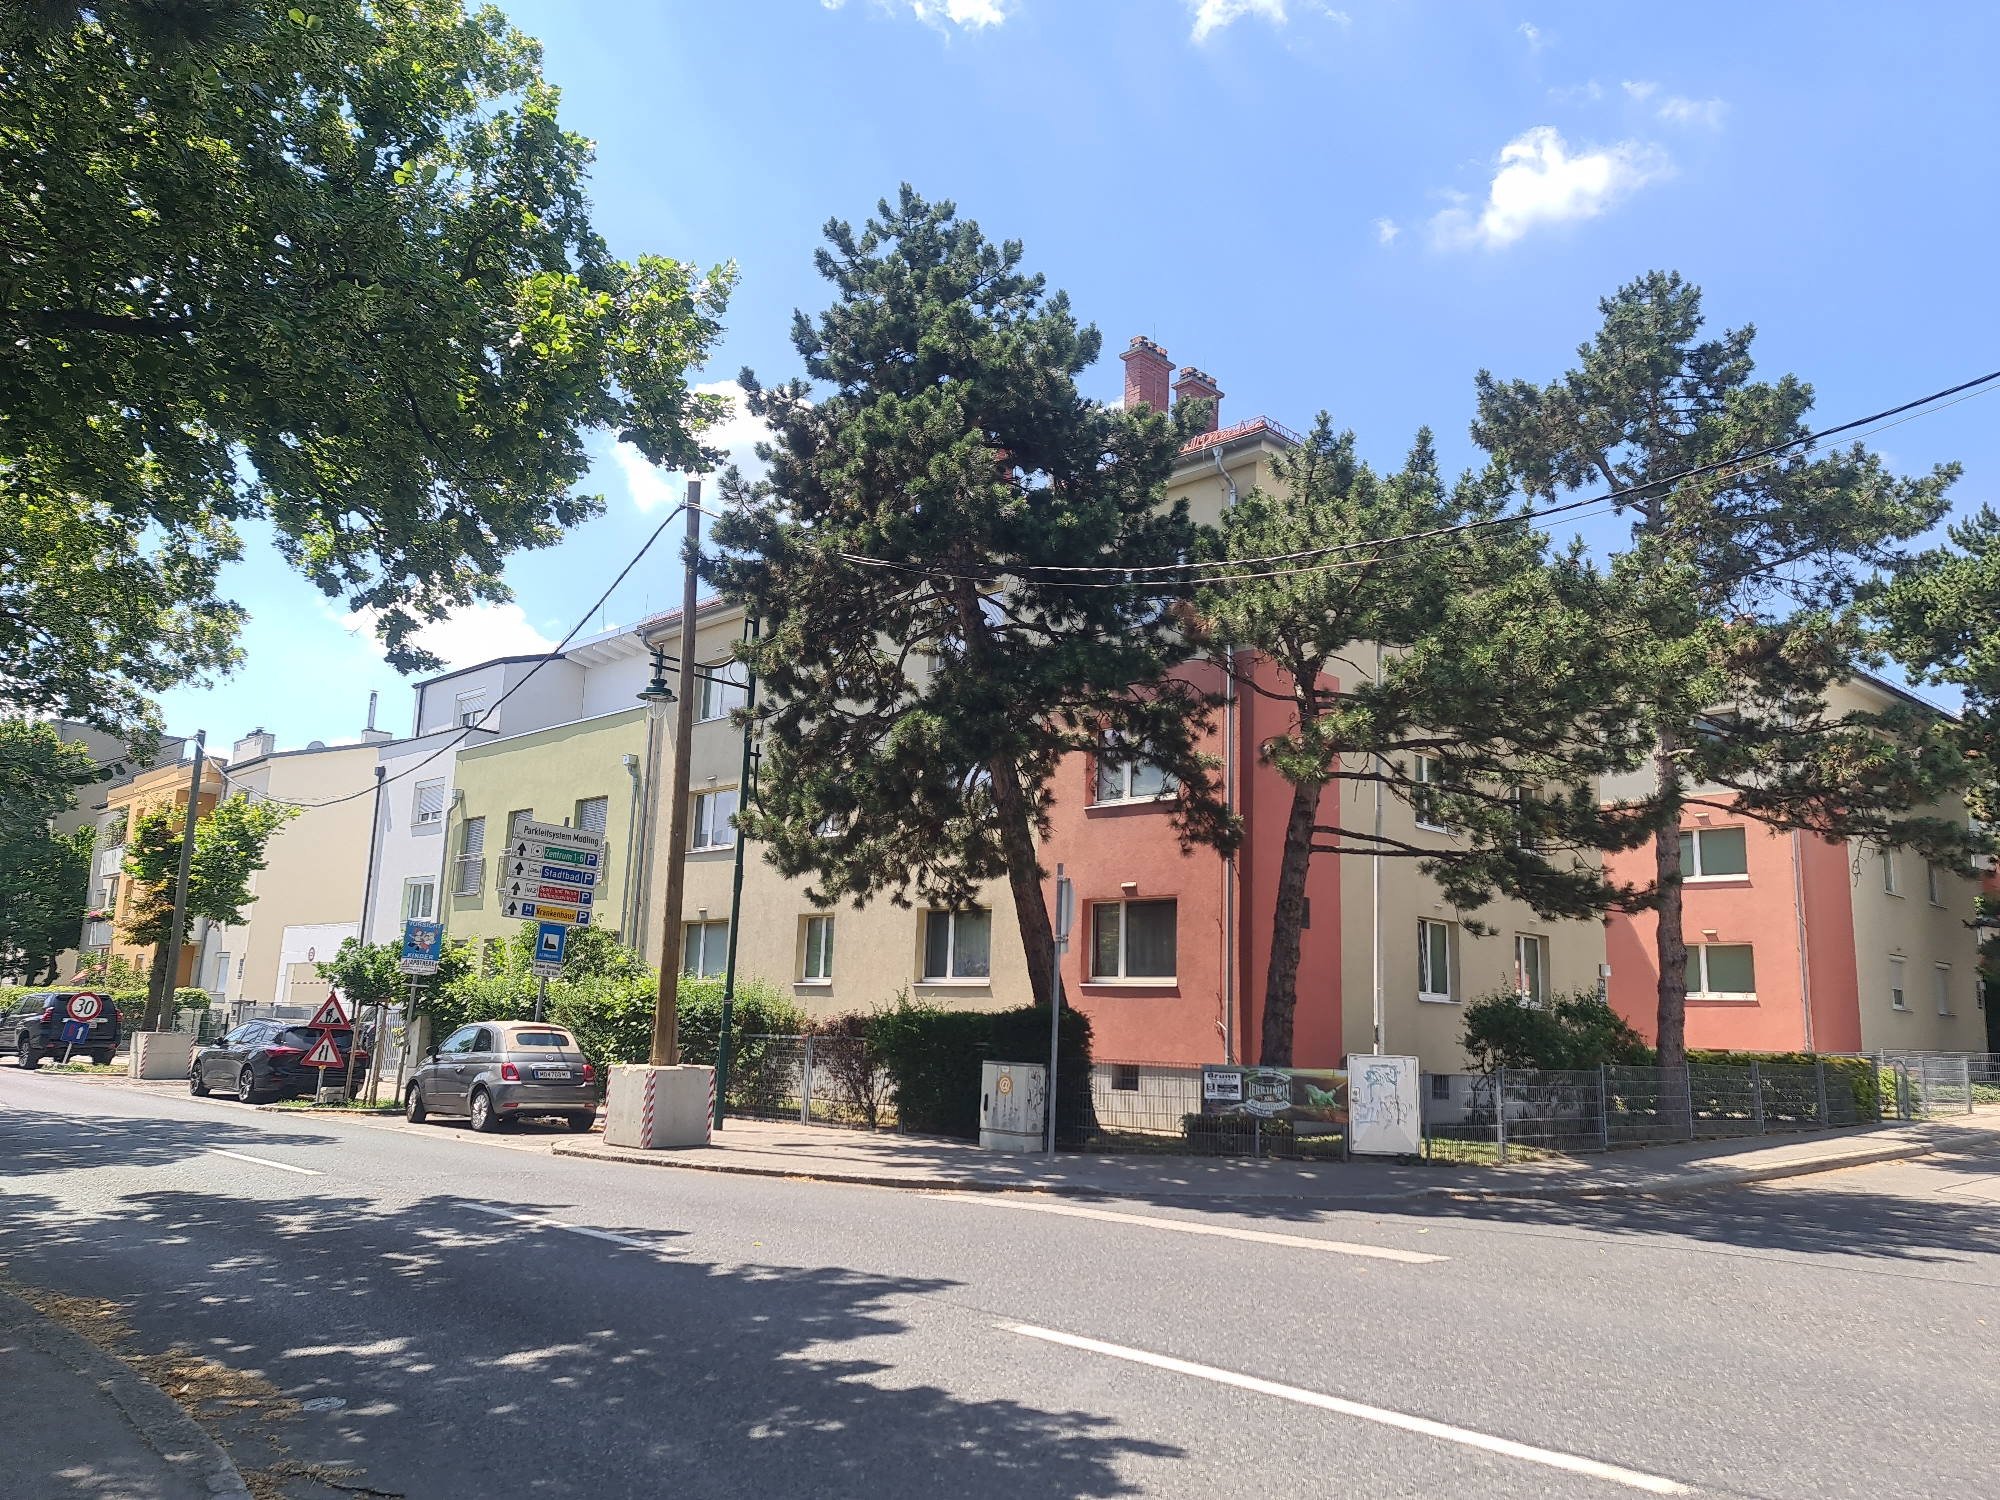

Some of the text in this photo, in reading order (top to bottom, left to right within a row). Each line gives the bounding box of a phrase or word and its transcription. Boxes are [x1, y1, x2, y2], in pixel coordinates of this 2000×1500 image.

[523, 825, 572, 841] Parkleitsystem
[545, 848, 573, 861] Zentrum
[586, 854, 596, 865] P
[544, 868, 580, 881] Stadtbad
[584, 873, 593, 884] P
[581, 892, 590, 903] P
[525, 904, 533, 912] H
[536, 907, 576, 920] Krankenhaus
[578, 912, 588, 923] P
[408, 920, 441, 929] VORSICHT
[407, 952, 434, 960] KINDER
[73, 998, 95, 1015] 30
